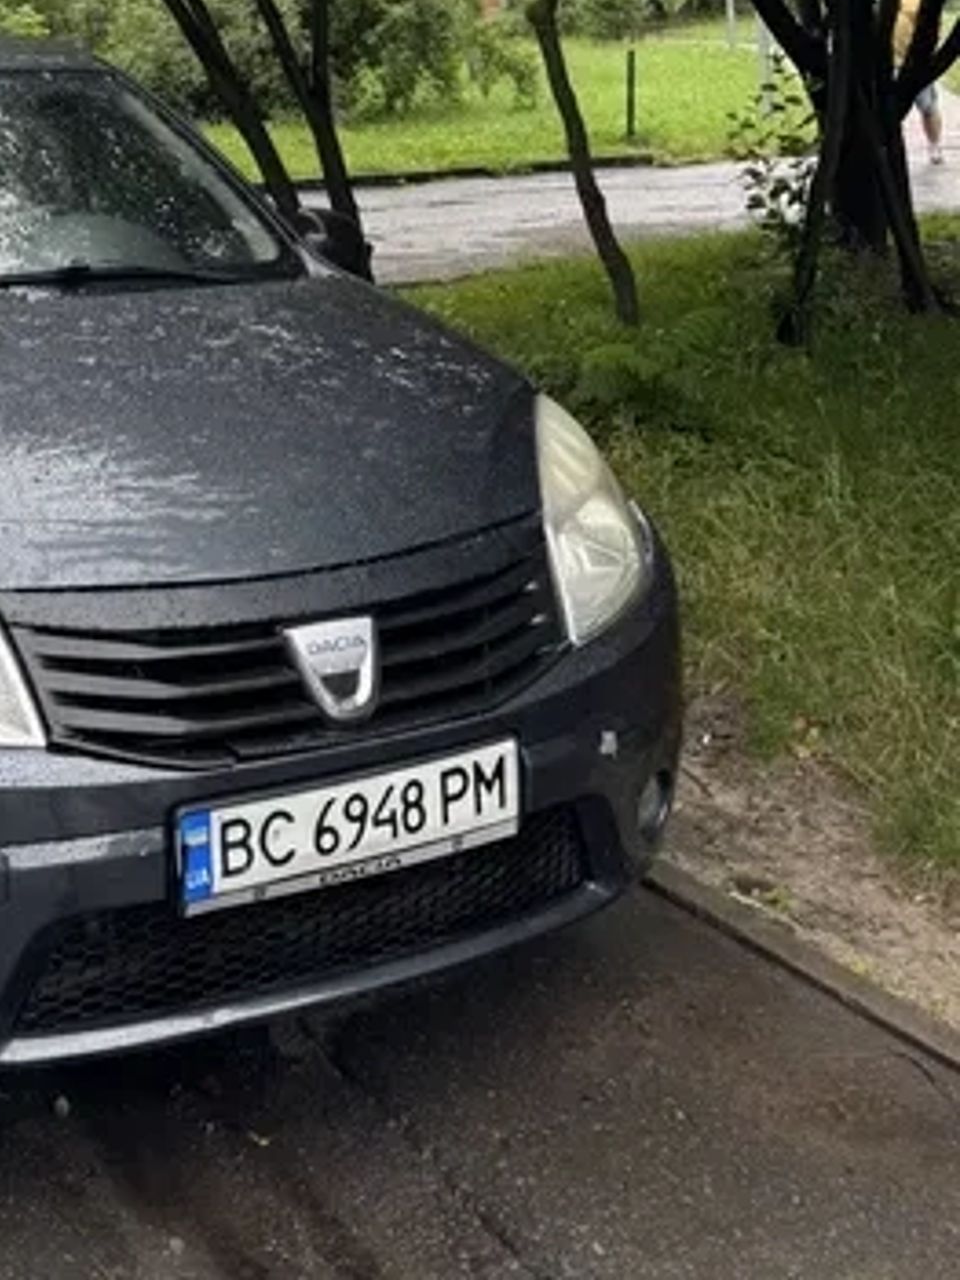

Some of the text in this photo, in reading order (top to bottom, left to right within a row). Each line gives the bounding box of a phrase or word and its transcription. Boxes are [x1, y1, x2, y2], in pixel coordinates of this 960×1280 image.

[306, 634, 367, 655] DACIA
[221, 811, 296, 878] BC
[313, 778, 427, 856] 6948
[441, 754, 507, 825] PM
[186, 867, 210, 890] UA
